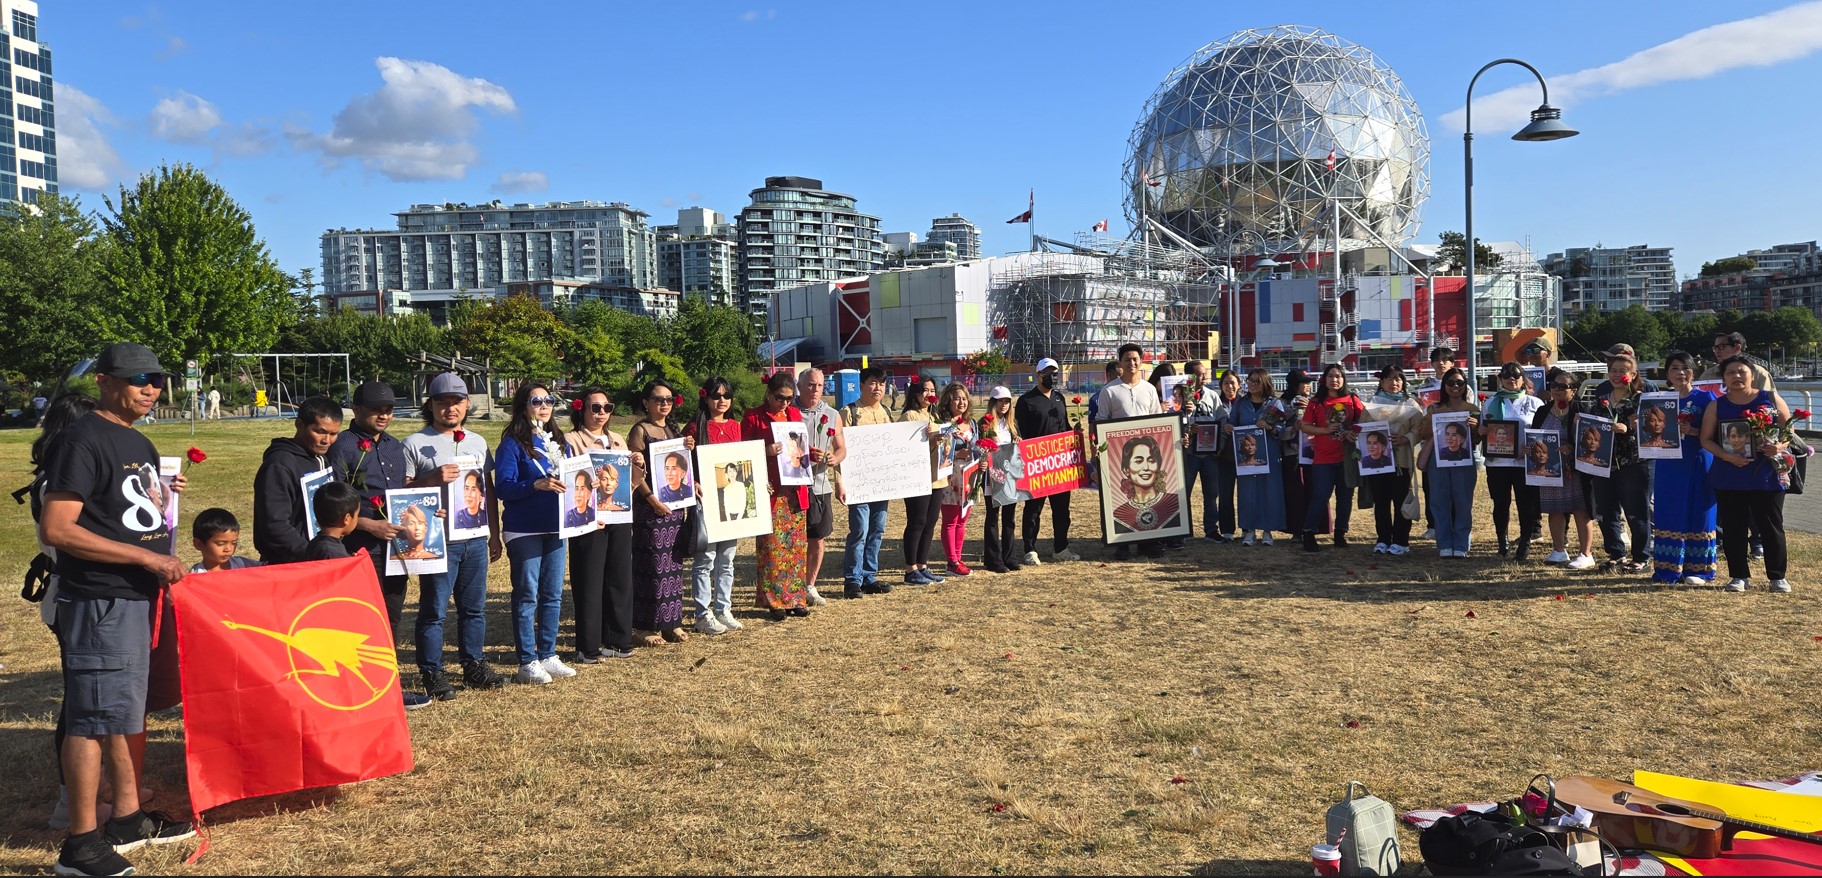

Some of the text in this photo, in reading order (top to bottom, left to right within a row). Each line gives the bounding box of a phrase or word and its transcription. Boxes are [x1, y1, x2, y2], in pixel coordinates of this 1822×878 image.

[1665, 401, 1676, 409] 80
[1106, 429, 1141, 439] FREEDOM
[1152, 426, 1172, 434] LEAD
[1601, 424, 1611, 432] 80
[1546, 435, 1556, 443] 80
[1026, 434, 1080, 459] JUSTICE FOR
[617, 457, 629, 466] 80
[1027, 449, 1082, 477] DEMOCRACY
[1029, 477, 1041, 491] IN
[1041, 465, 1085, 488] MYANMAR
[423, 496, 437, 506] 80
